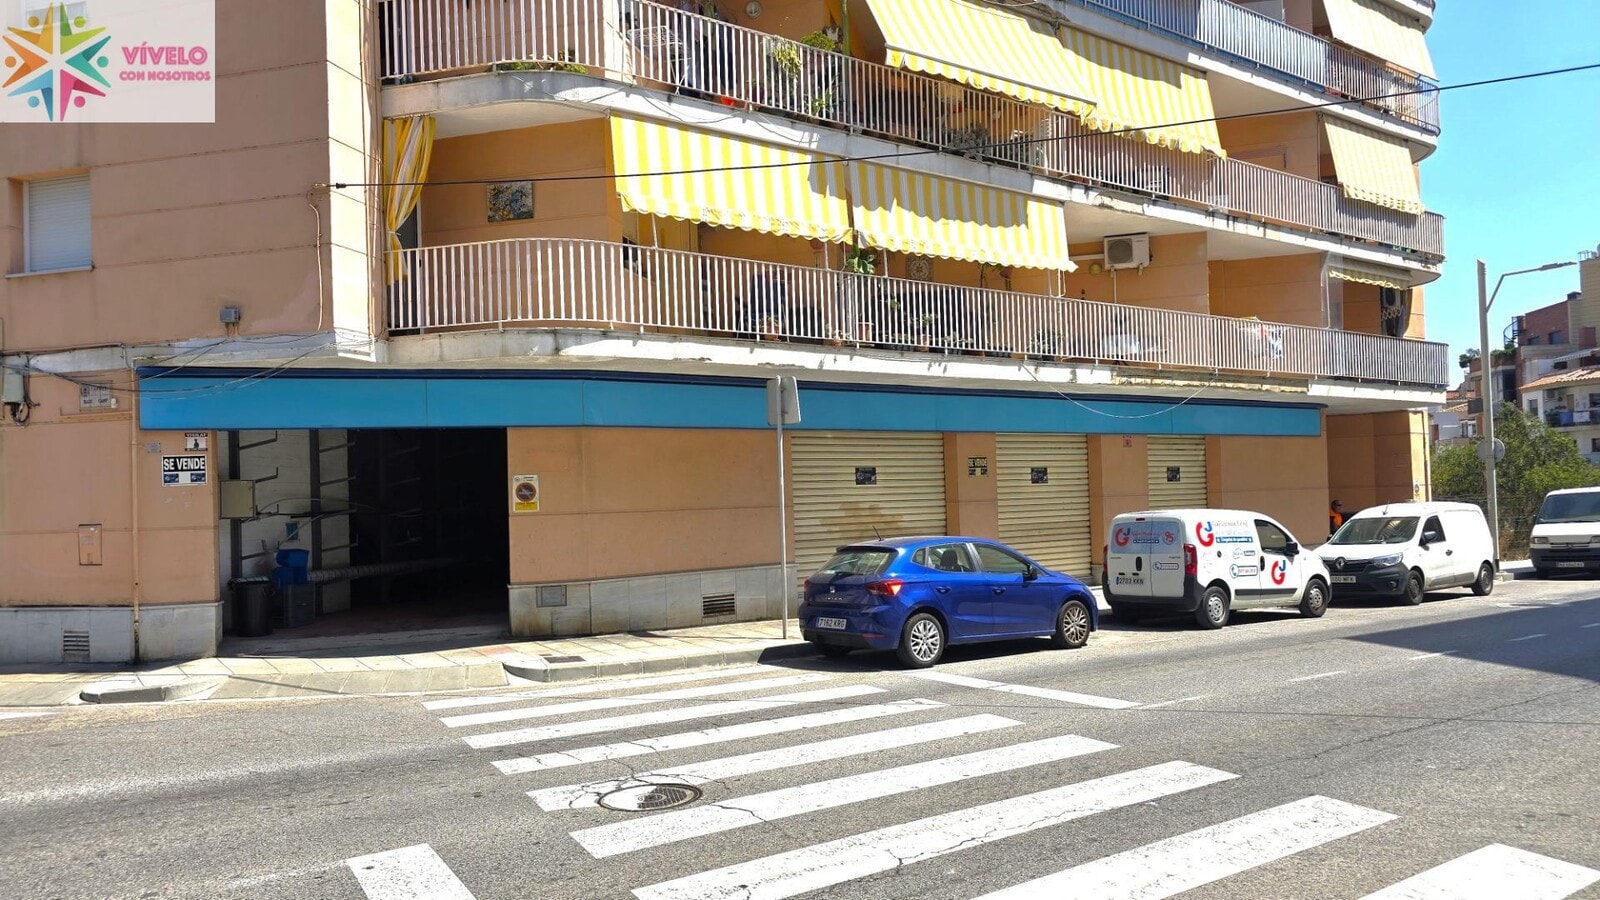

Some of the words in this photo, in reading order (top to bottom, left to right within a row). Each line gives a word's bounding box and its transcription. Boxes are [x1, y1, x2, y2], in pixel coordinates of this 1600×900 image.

[163, 458, 175, 470] SE
[176, 457, 205, 470] VENDE
[968, 458, 974, 467] SE
[975, 458, 987, 467] VENDE
